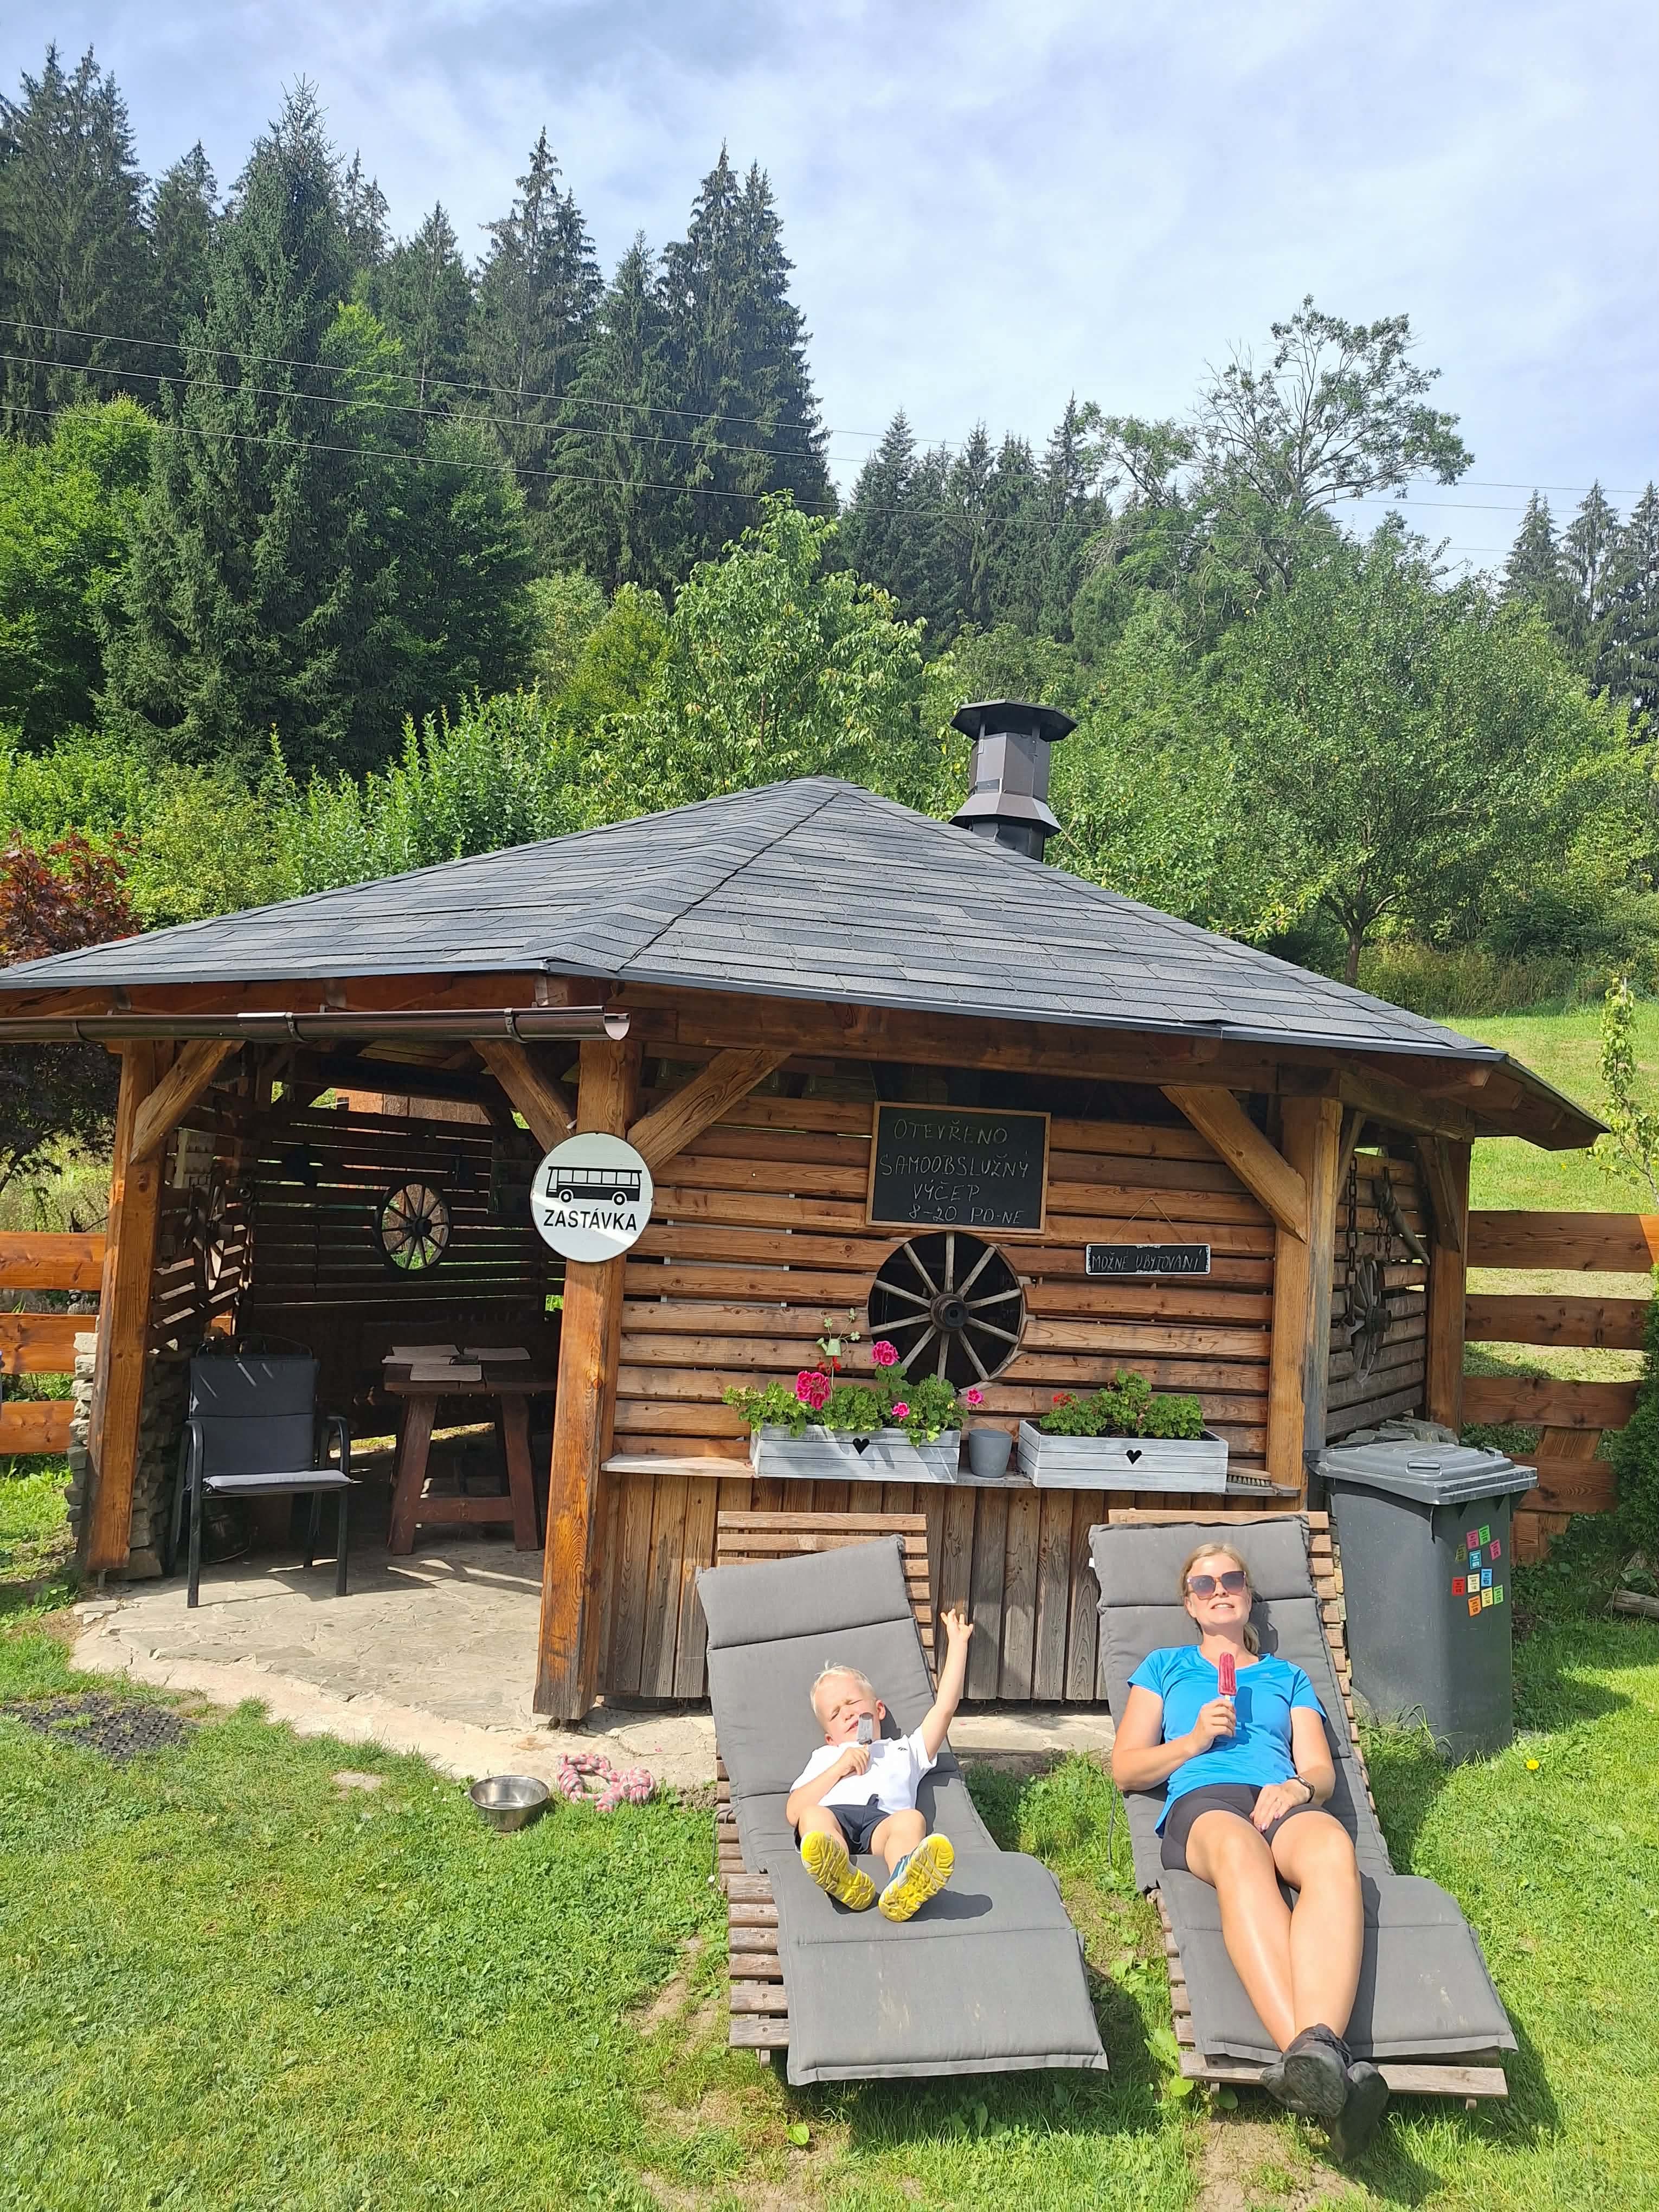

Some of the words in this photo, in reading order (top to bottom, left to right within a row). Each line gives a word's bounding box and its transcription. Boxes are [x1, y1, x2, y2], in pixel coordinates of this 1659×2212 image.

[894, 1118, 1008, 1145] OTEVŘENO
[879, 1149, 1028, 1178] SAMOOBSLUŽNÝ
[914, 1179, 980, 1202] VÝČEP
[543, 1208, 637, 1231] ZASTÁVKA
[908, 1204, 957, 1221] 8-20
[970, 1207, 1025, 1224] PO-NE
